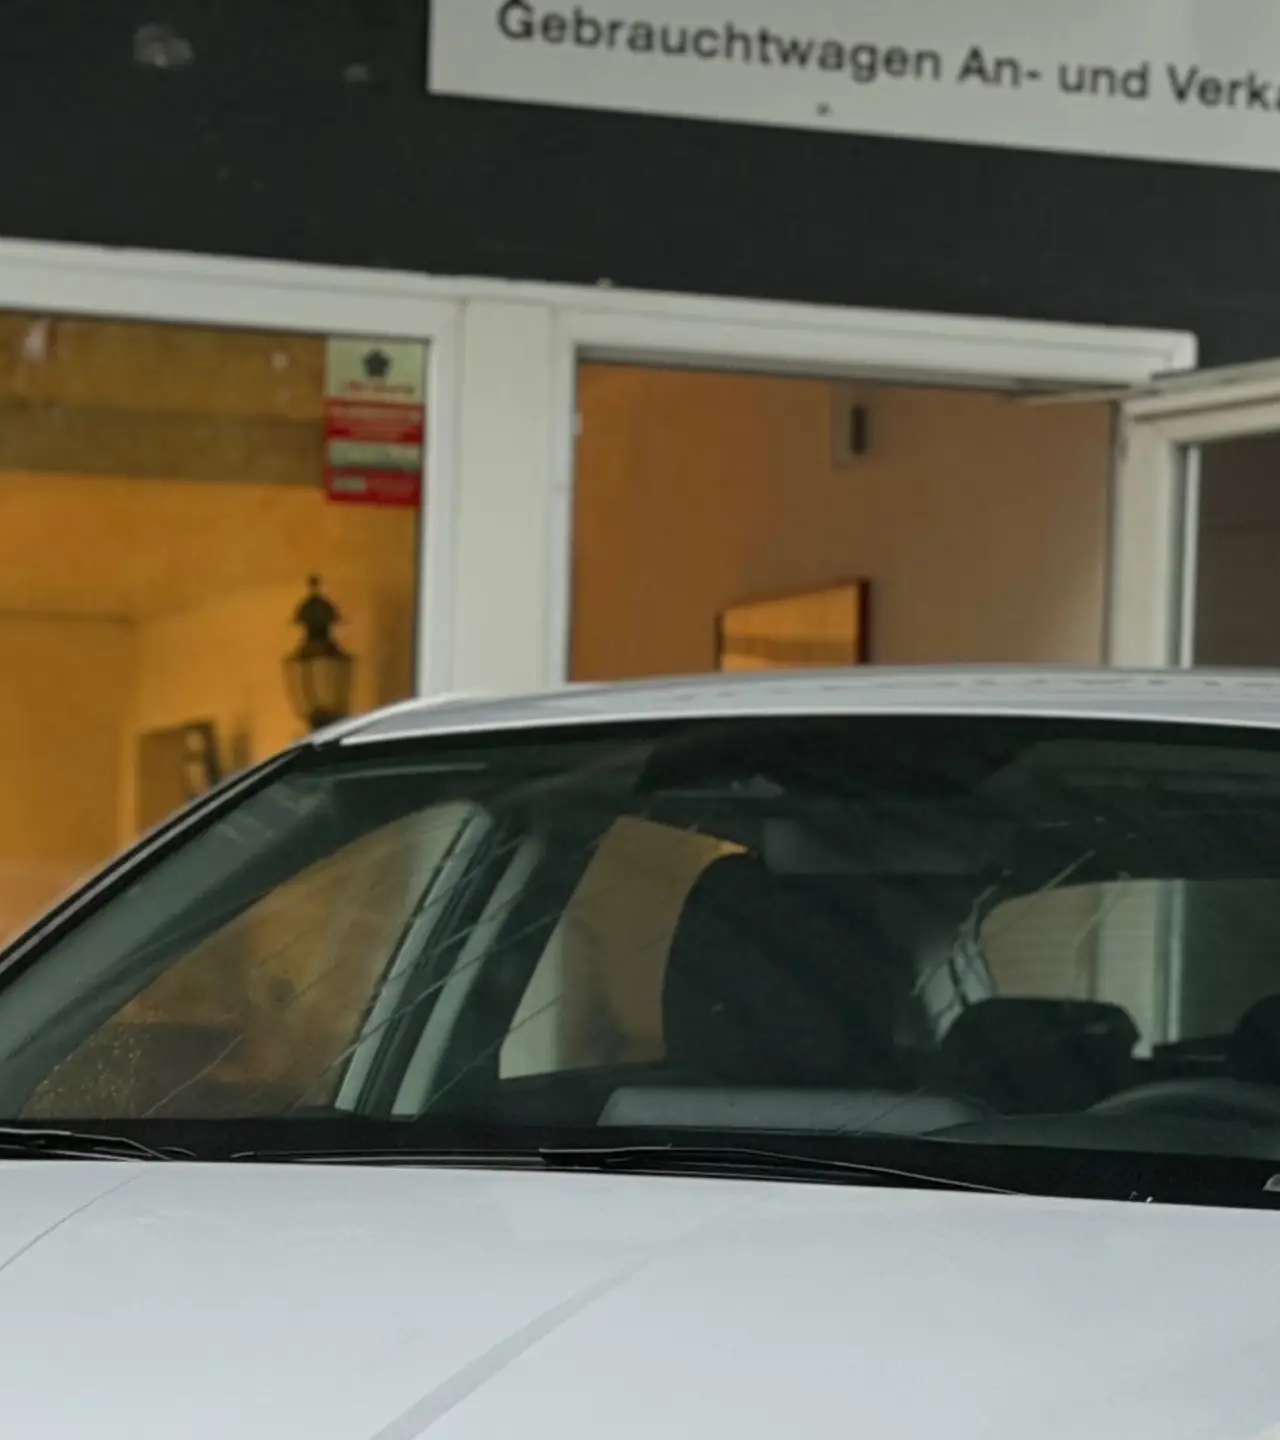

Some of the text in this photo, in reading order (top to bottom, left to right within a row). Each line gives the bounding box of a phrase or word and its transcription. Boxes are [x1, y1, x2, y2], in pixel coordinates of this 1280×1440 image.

[495, 0, 942, 85] Gebrauchtwagen
[957, 45, 1041, 88] An-
[1057, 62, 1151, 101] und
